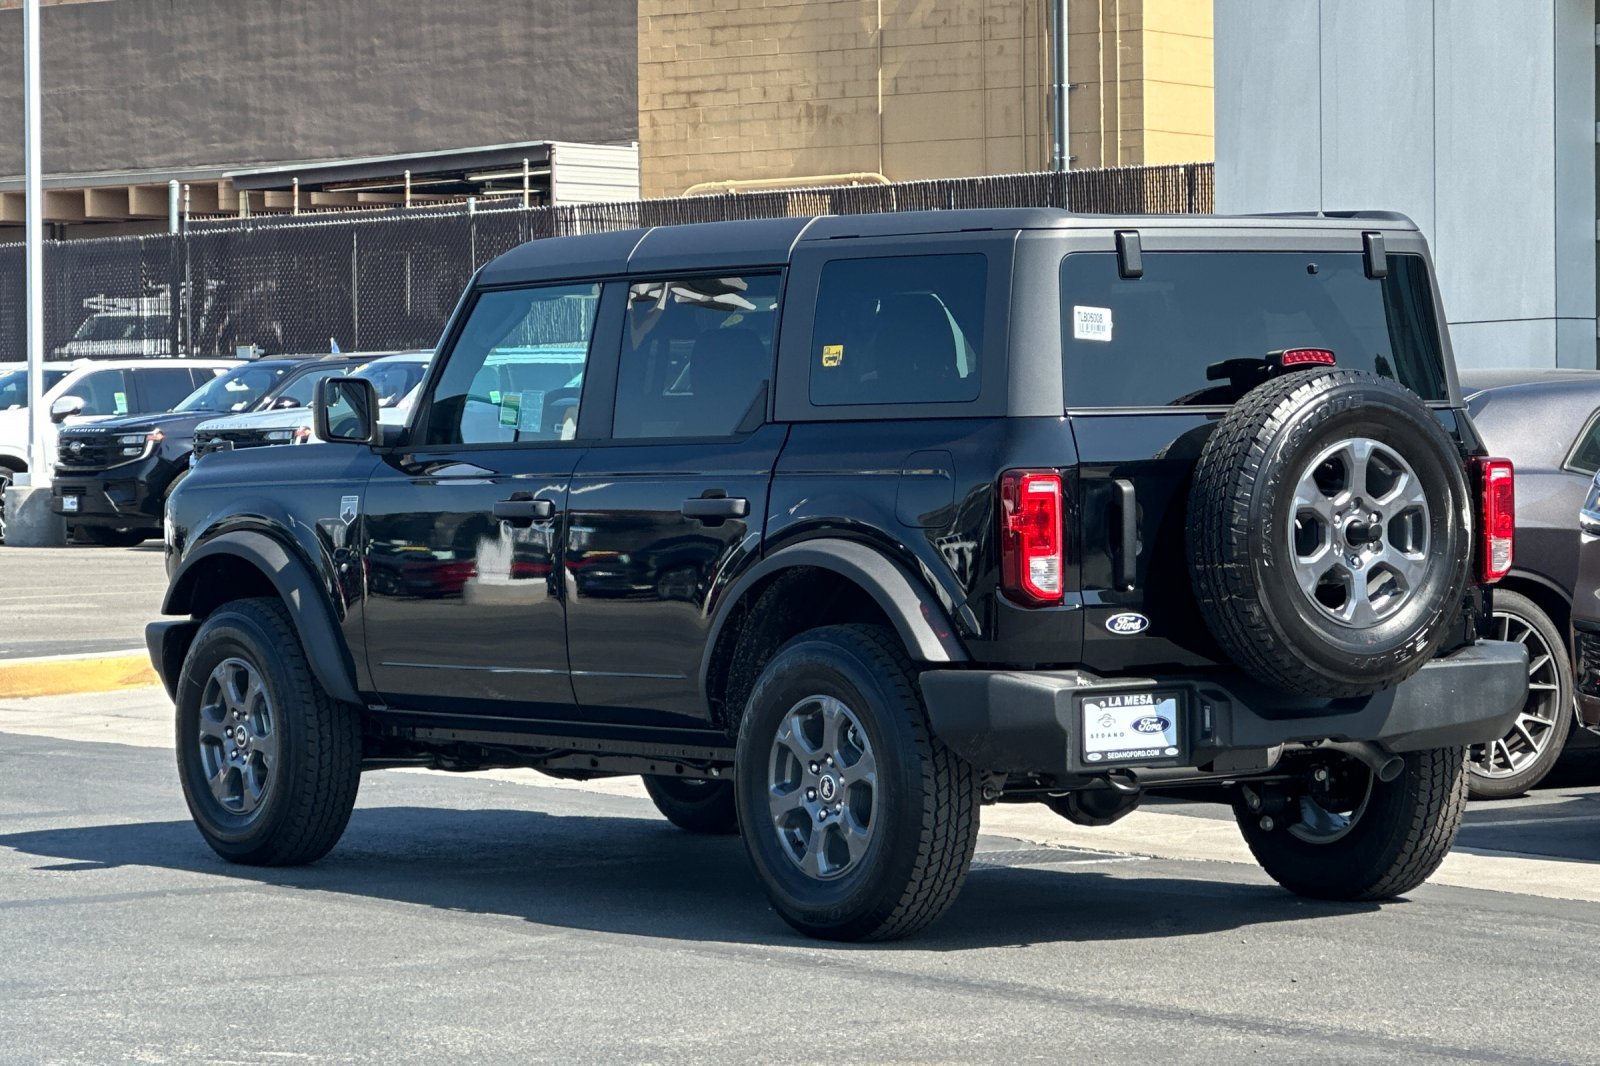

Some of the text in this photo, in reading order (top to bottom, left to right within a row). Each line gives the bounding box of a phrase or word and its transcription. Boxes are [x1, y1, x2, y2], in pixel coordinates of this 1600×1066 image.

[1113, 615, 1143, 631] Ford
[1108, 694, 1153, 707] LA MESA
[1138, 716, 1164, 732] Ford
[1090, 731, 1125, 739] SEDANO
[1107, 749, 1160, 759] SEDANOFORD.COM
